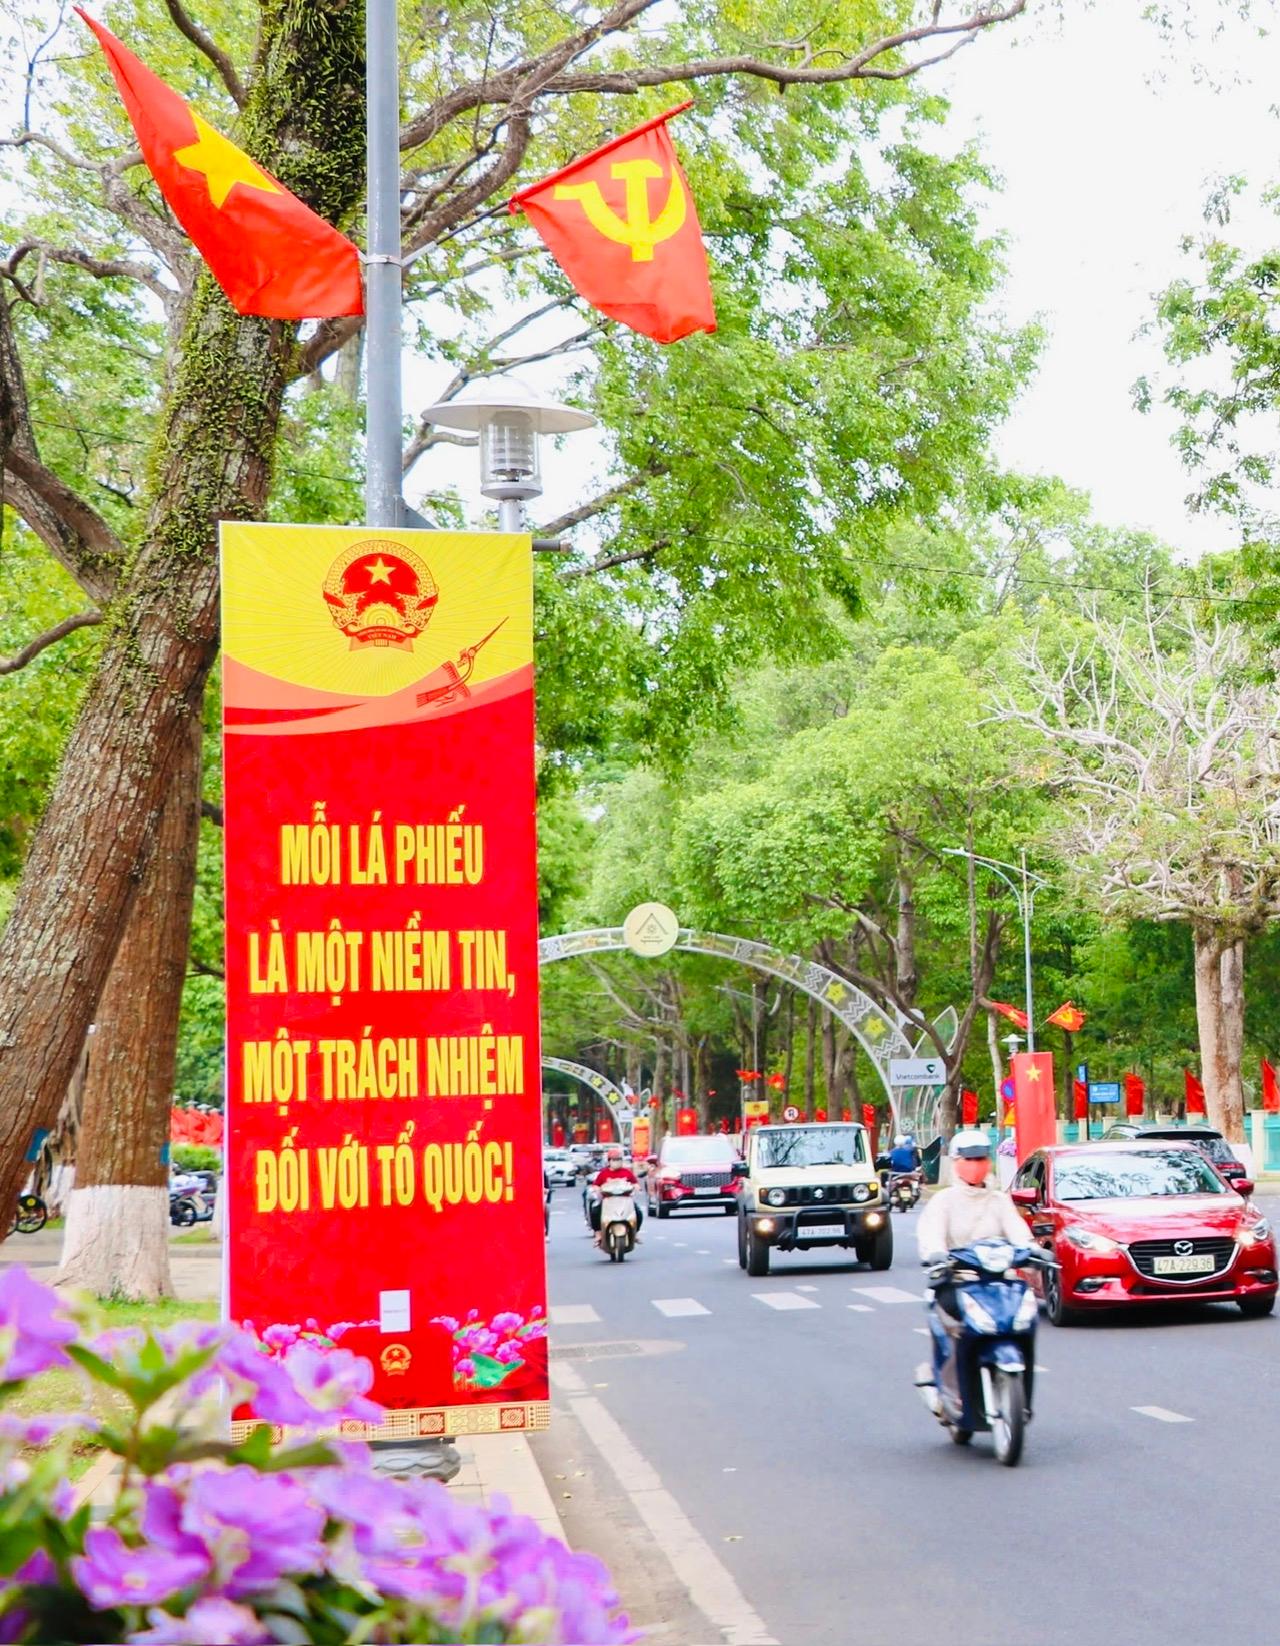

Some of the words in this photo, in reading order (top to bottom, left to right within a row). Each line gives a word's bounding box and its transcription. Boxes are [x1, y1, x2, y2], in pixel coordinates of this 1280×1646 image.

[281, 801, 341, 886] MỖI
[350, 811, 388, 885] LÁ
[396, 804, 483, 885] PHIẾU
[249, 919, 288, 993] LÀ
[297, 919, 364, 1006] MỘT
[371, 911, 449, 990] NIỀM
[459, 930, 515, 998] TIN,
[243, 1028, 310, 1116] MỘT
[318, 1025, 418, 1098] TRÁCH
[427, 1023, 525, 1109] NHIỆM
[256, 1127, 309, 1213] ĐỐI
[318, 1134, 369, 1209] VỚI
[377, 1120, 416, 1206] TỔ
[424, 1121, 515, 1213] QUỐC!
